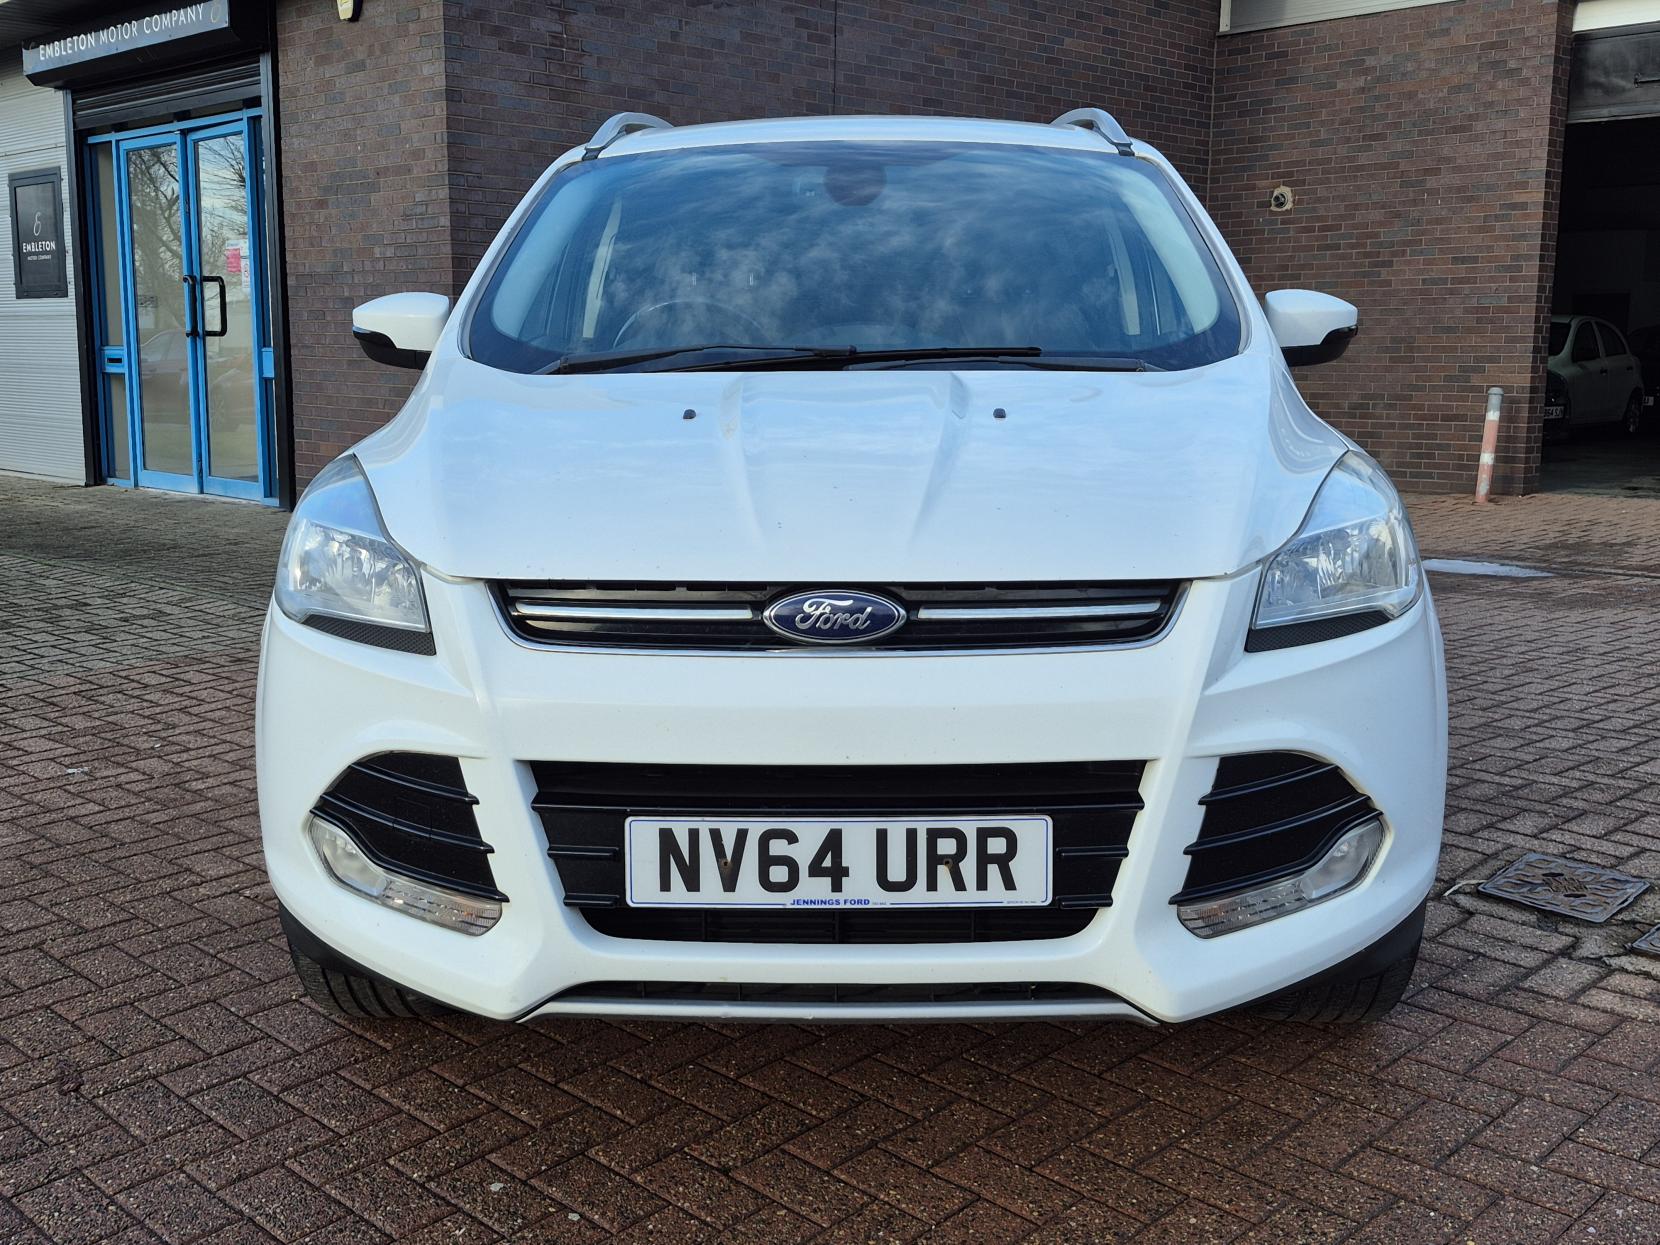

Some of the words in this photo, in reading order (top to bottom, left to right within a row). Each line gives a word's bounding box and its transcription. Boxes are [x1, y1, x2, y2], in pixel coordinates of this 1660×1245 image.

[39, 32, 96, 61] EMBLETON
[100, 20, 138, 45] MOTOR
[143, 3, 204, 34] COMPANY
[22, 241, 56, 253] EMBLETON
[795, 598, 873, 630] Ford
[658, 827, 850, 893] NV64
[875, 826, 1018, 892] URR
